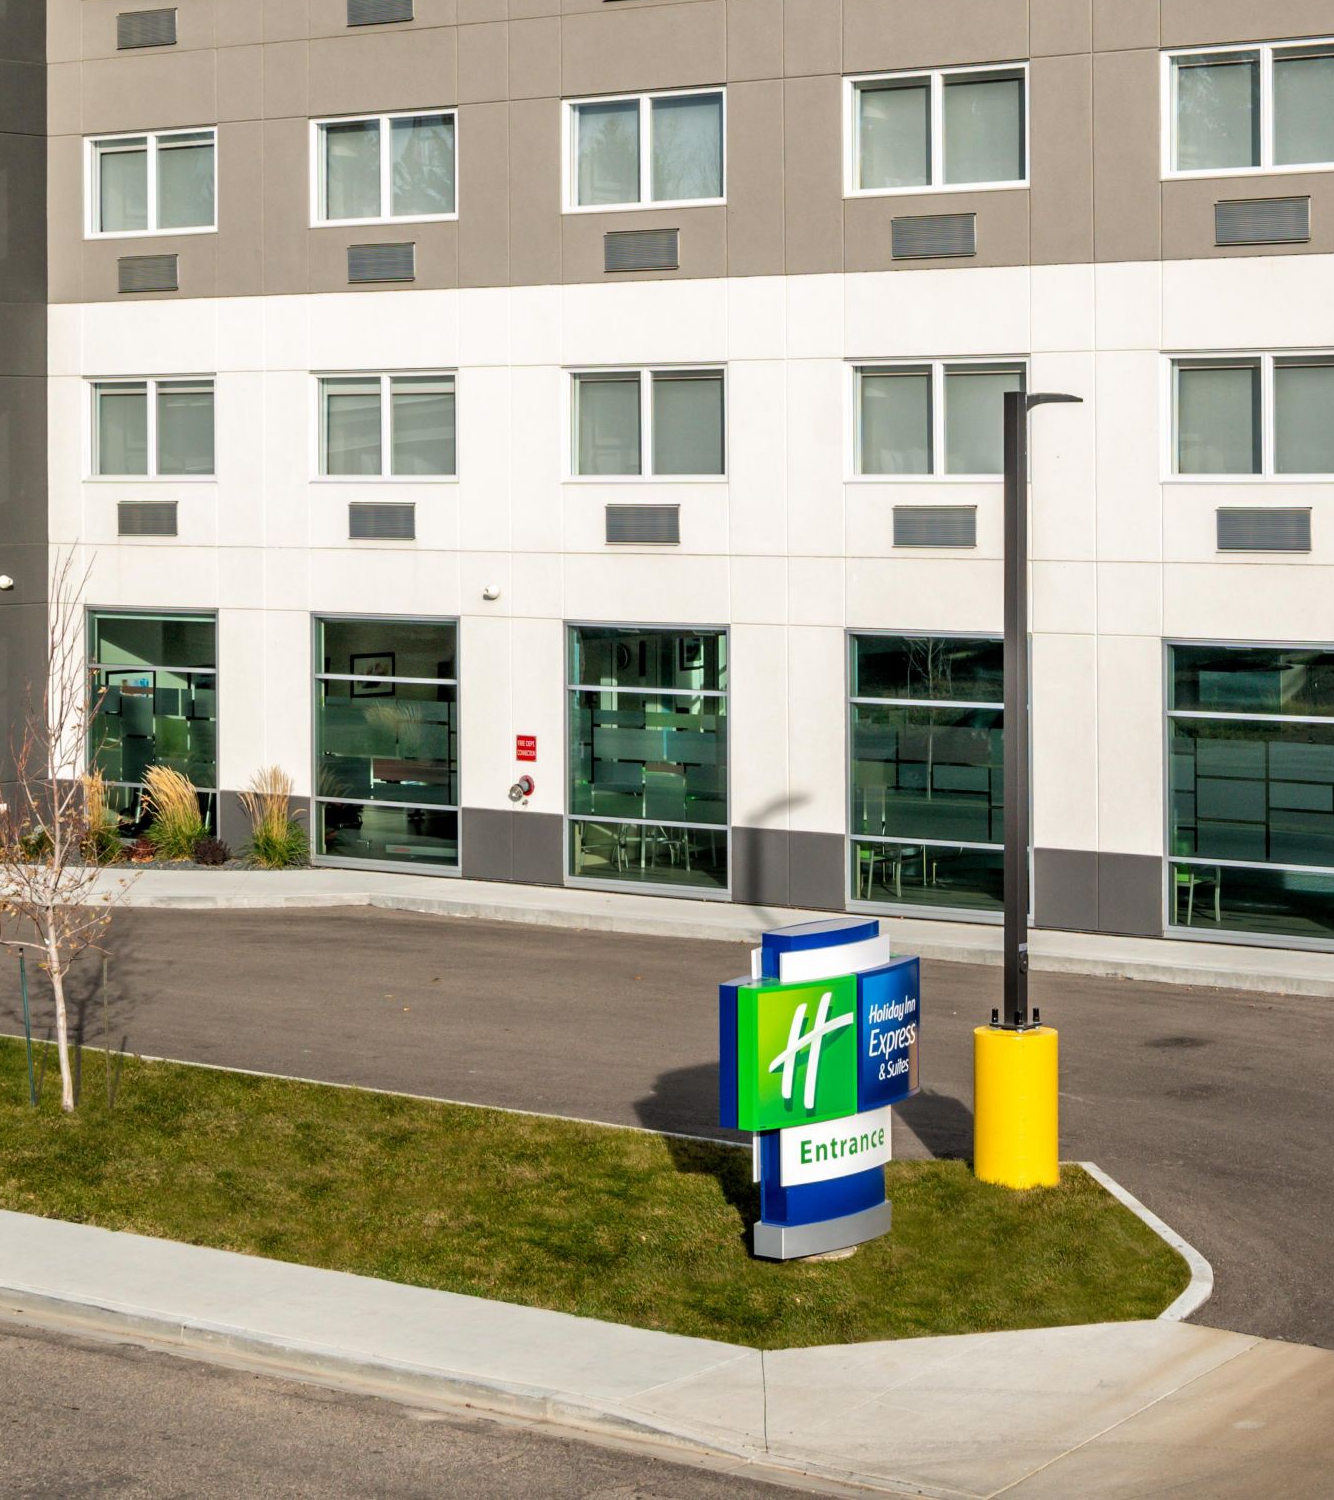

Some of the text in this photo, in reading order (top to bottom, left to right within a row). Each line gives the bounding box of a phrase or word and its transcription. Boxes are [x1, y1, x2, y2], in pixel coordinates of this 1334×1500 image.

[868, 995, 916, 1024] Holiday Inn
[869, 1023, 916, 1060] Express
[878, 1058, 909, 1080] & Suites
[800, 1127, 885, 1165] Entrance
